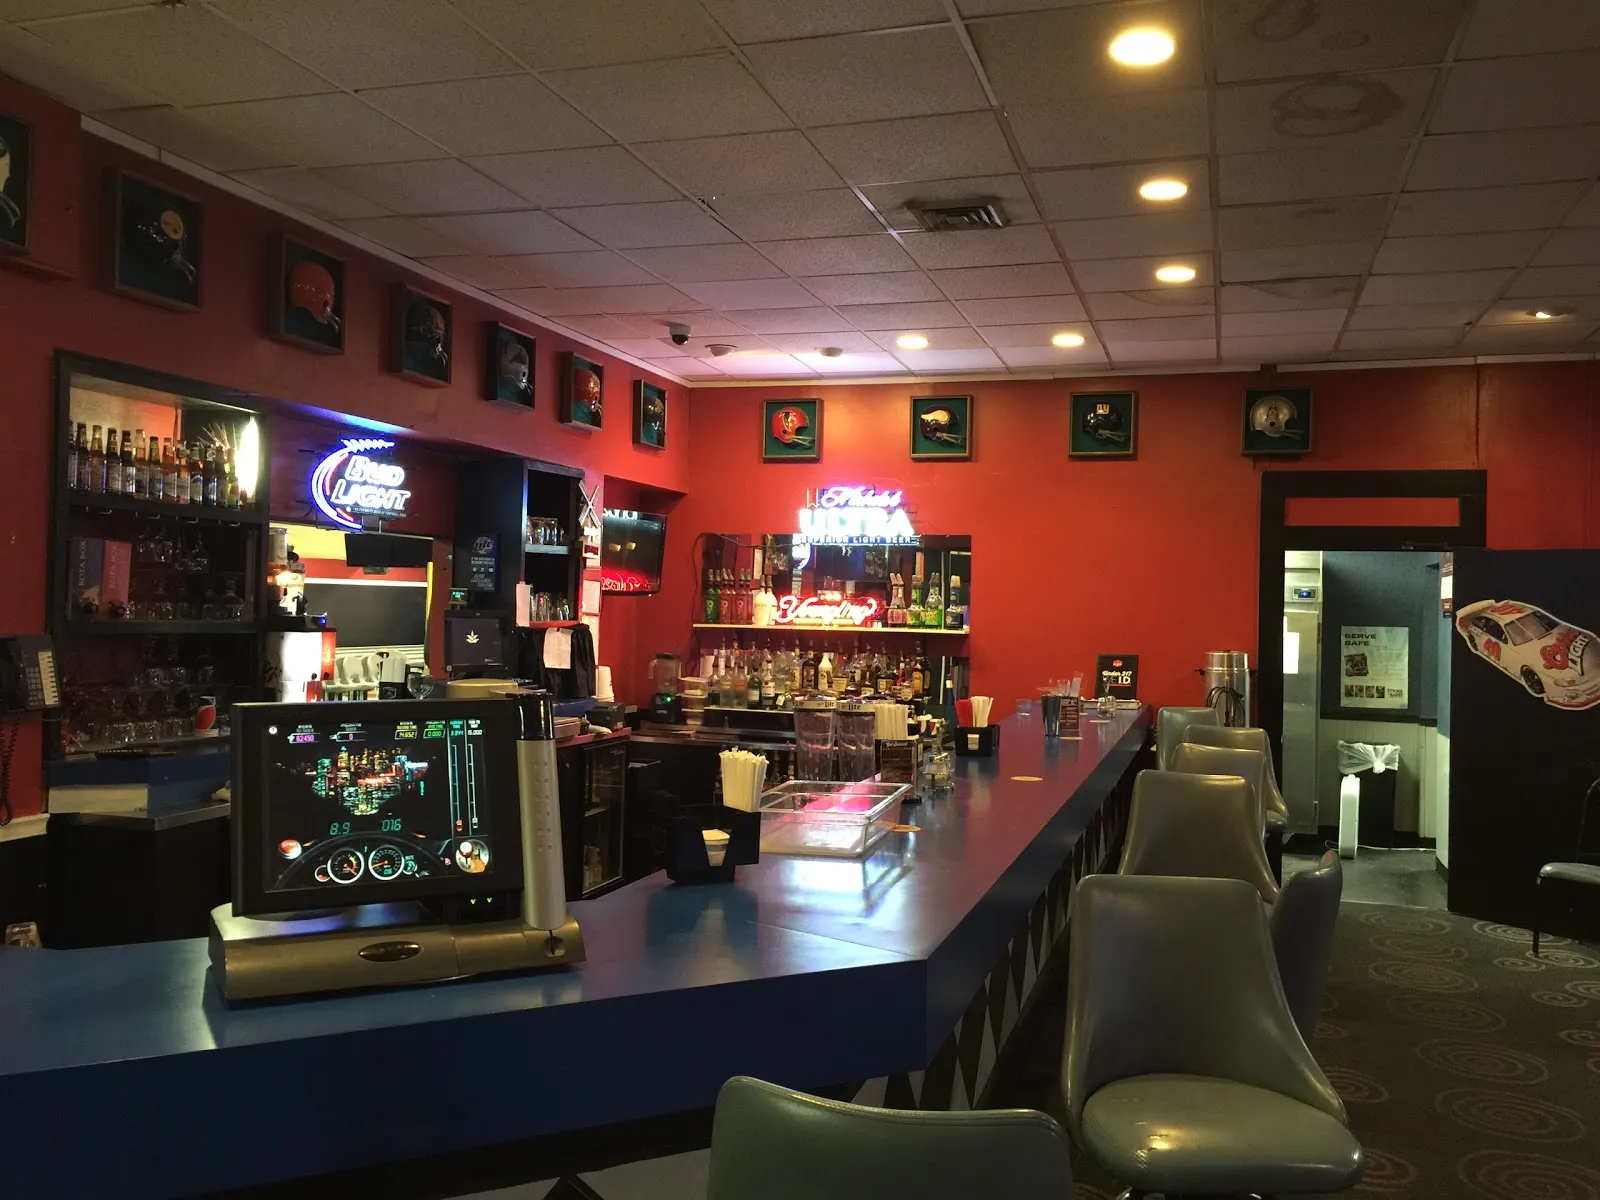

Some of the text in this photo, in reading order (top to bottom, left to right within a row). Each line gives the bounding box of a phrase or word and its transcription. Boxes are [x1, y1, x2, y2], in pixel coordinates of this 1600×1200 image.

[344, 454, 406, 487] BUD
[330, 478, 412, 511] LIGHT
[852, 535, 882, 544] LIGHT
[885, 535, 911, 544] BEER
[79, 540, 87, 559] BOX
[1568, 634, 1591, 677] LIGHT
[848, 703, 861, 711] Lite
[329, 822, 350, 836] 8.9
